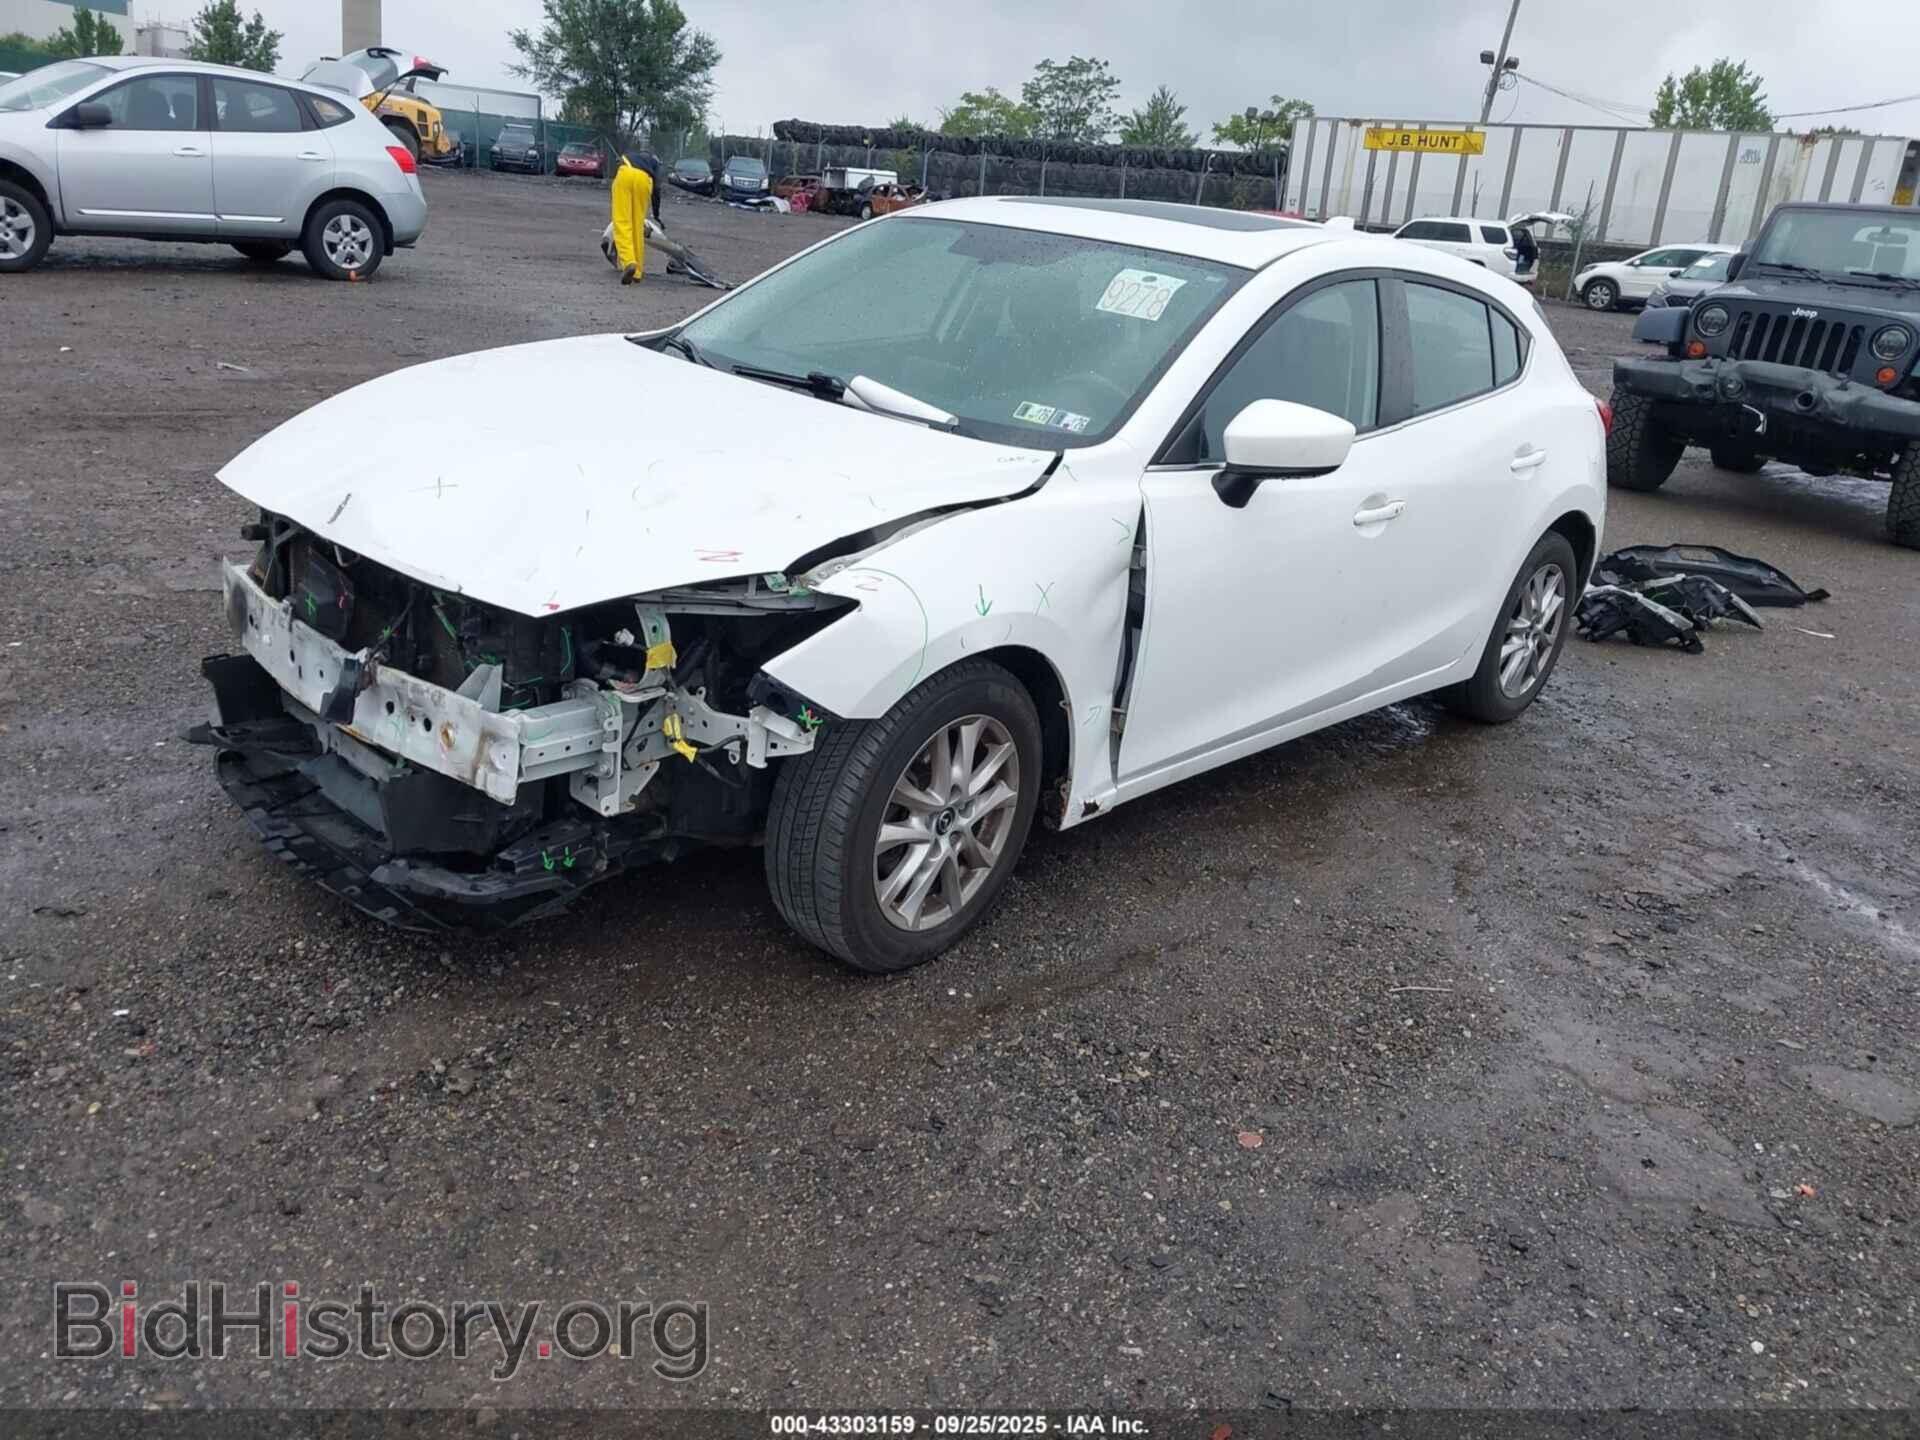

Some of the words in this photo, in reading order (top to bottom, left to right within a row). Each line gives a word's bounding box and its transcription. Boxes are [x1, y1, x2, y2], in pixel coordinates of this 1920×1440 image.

[1418, 135, 1460, 149] HUNT
[1102, 280, 1170, 318] 9278
[1791, 306, 1818, 319] Jeep
